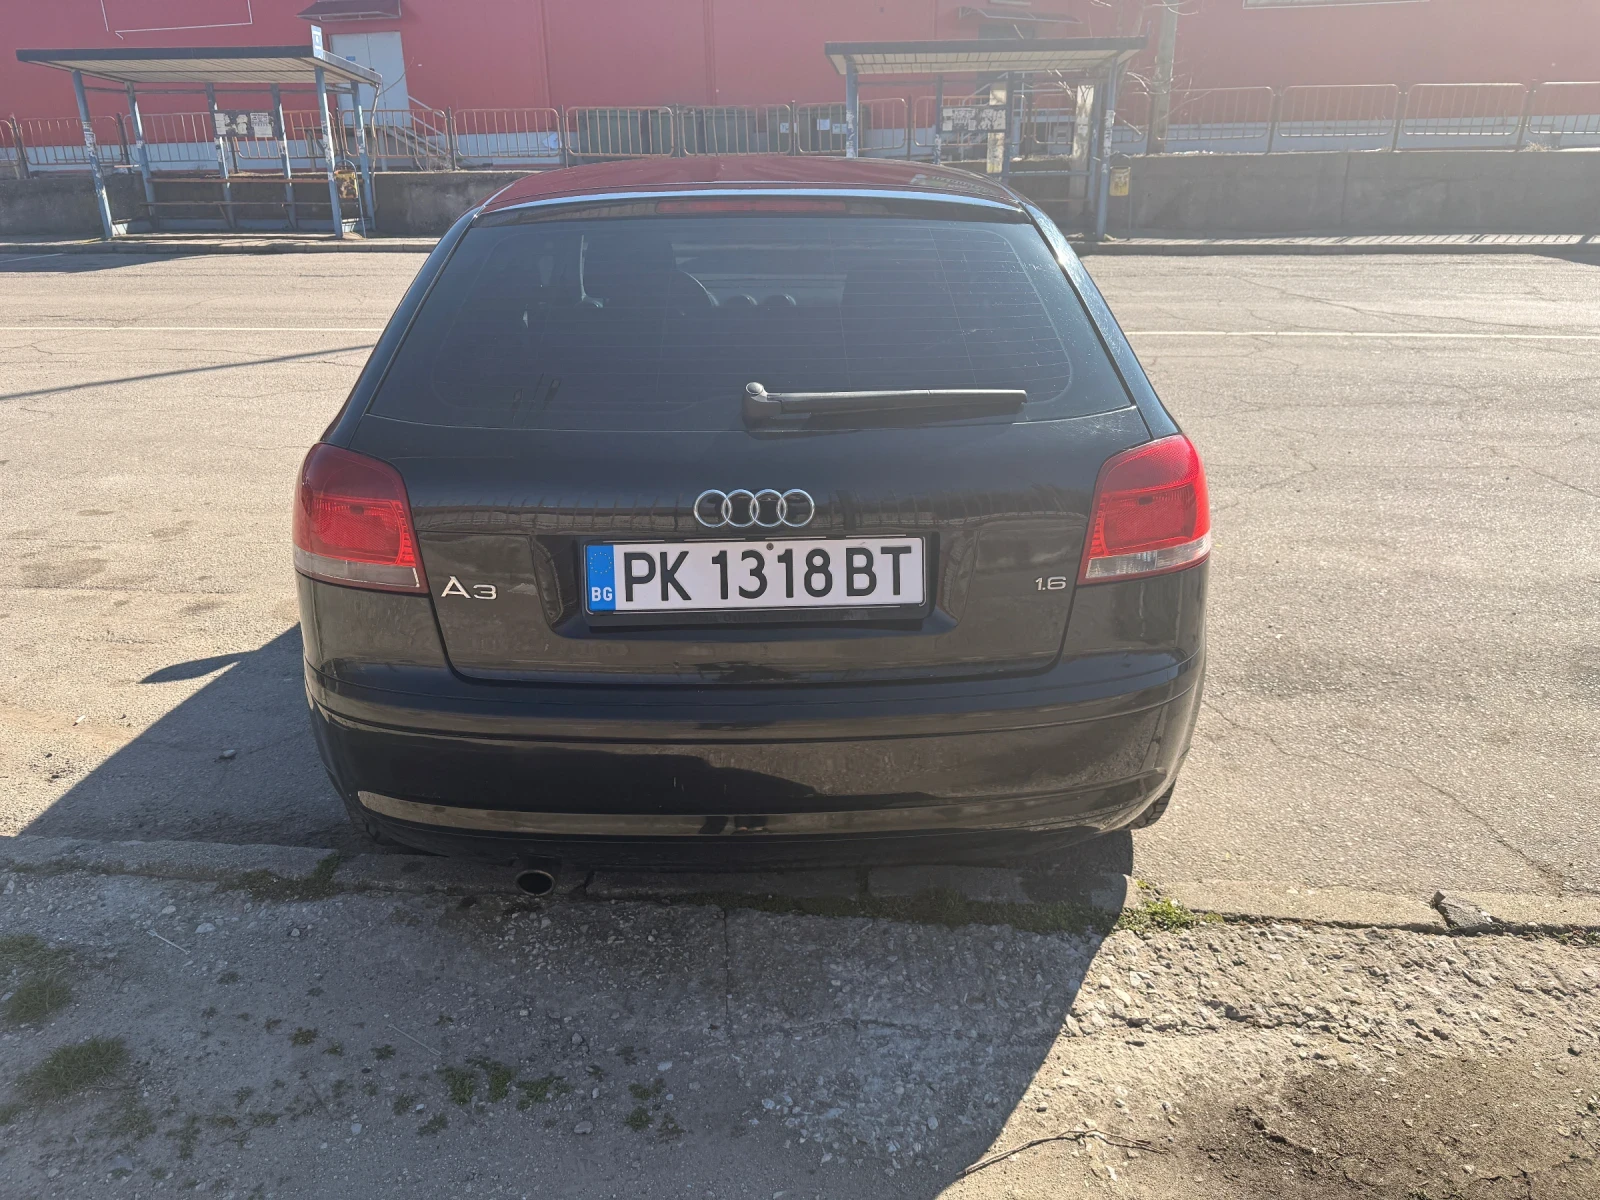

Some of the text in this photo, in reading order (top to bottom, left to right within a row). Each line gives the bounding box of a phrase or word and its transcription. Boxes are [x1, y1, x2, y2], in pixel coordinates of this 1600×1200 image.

[624, 551, 691, 601] PK
[1035, 576, 1067, 591] 1.6
[440, 575, 497, 600] A3
[591, 586, 613, 602] BG
